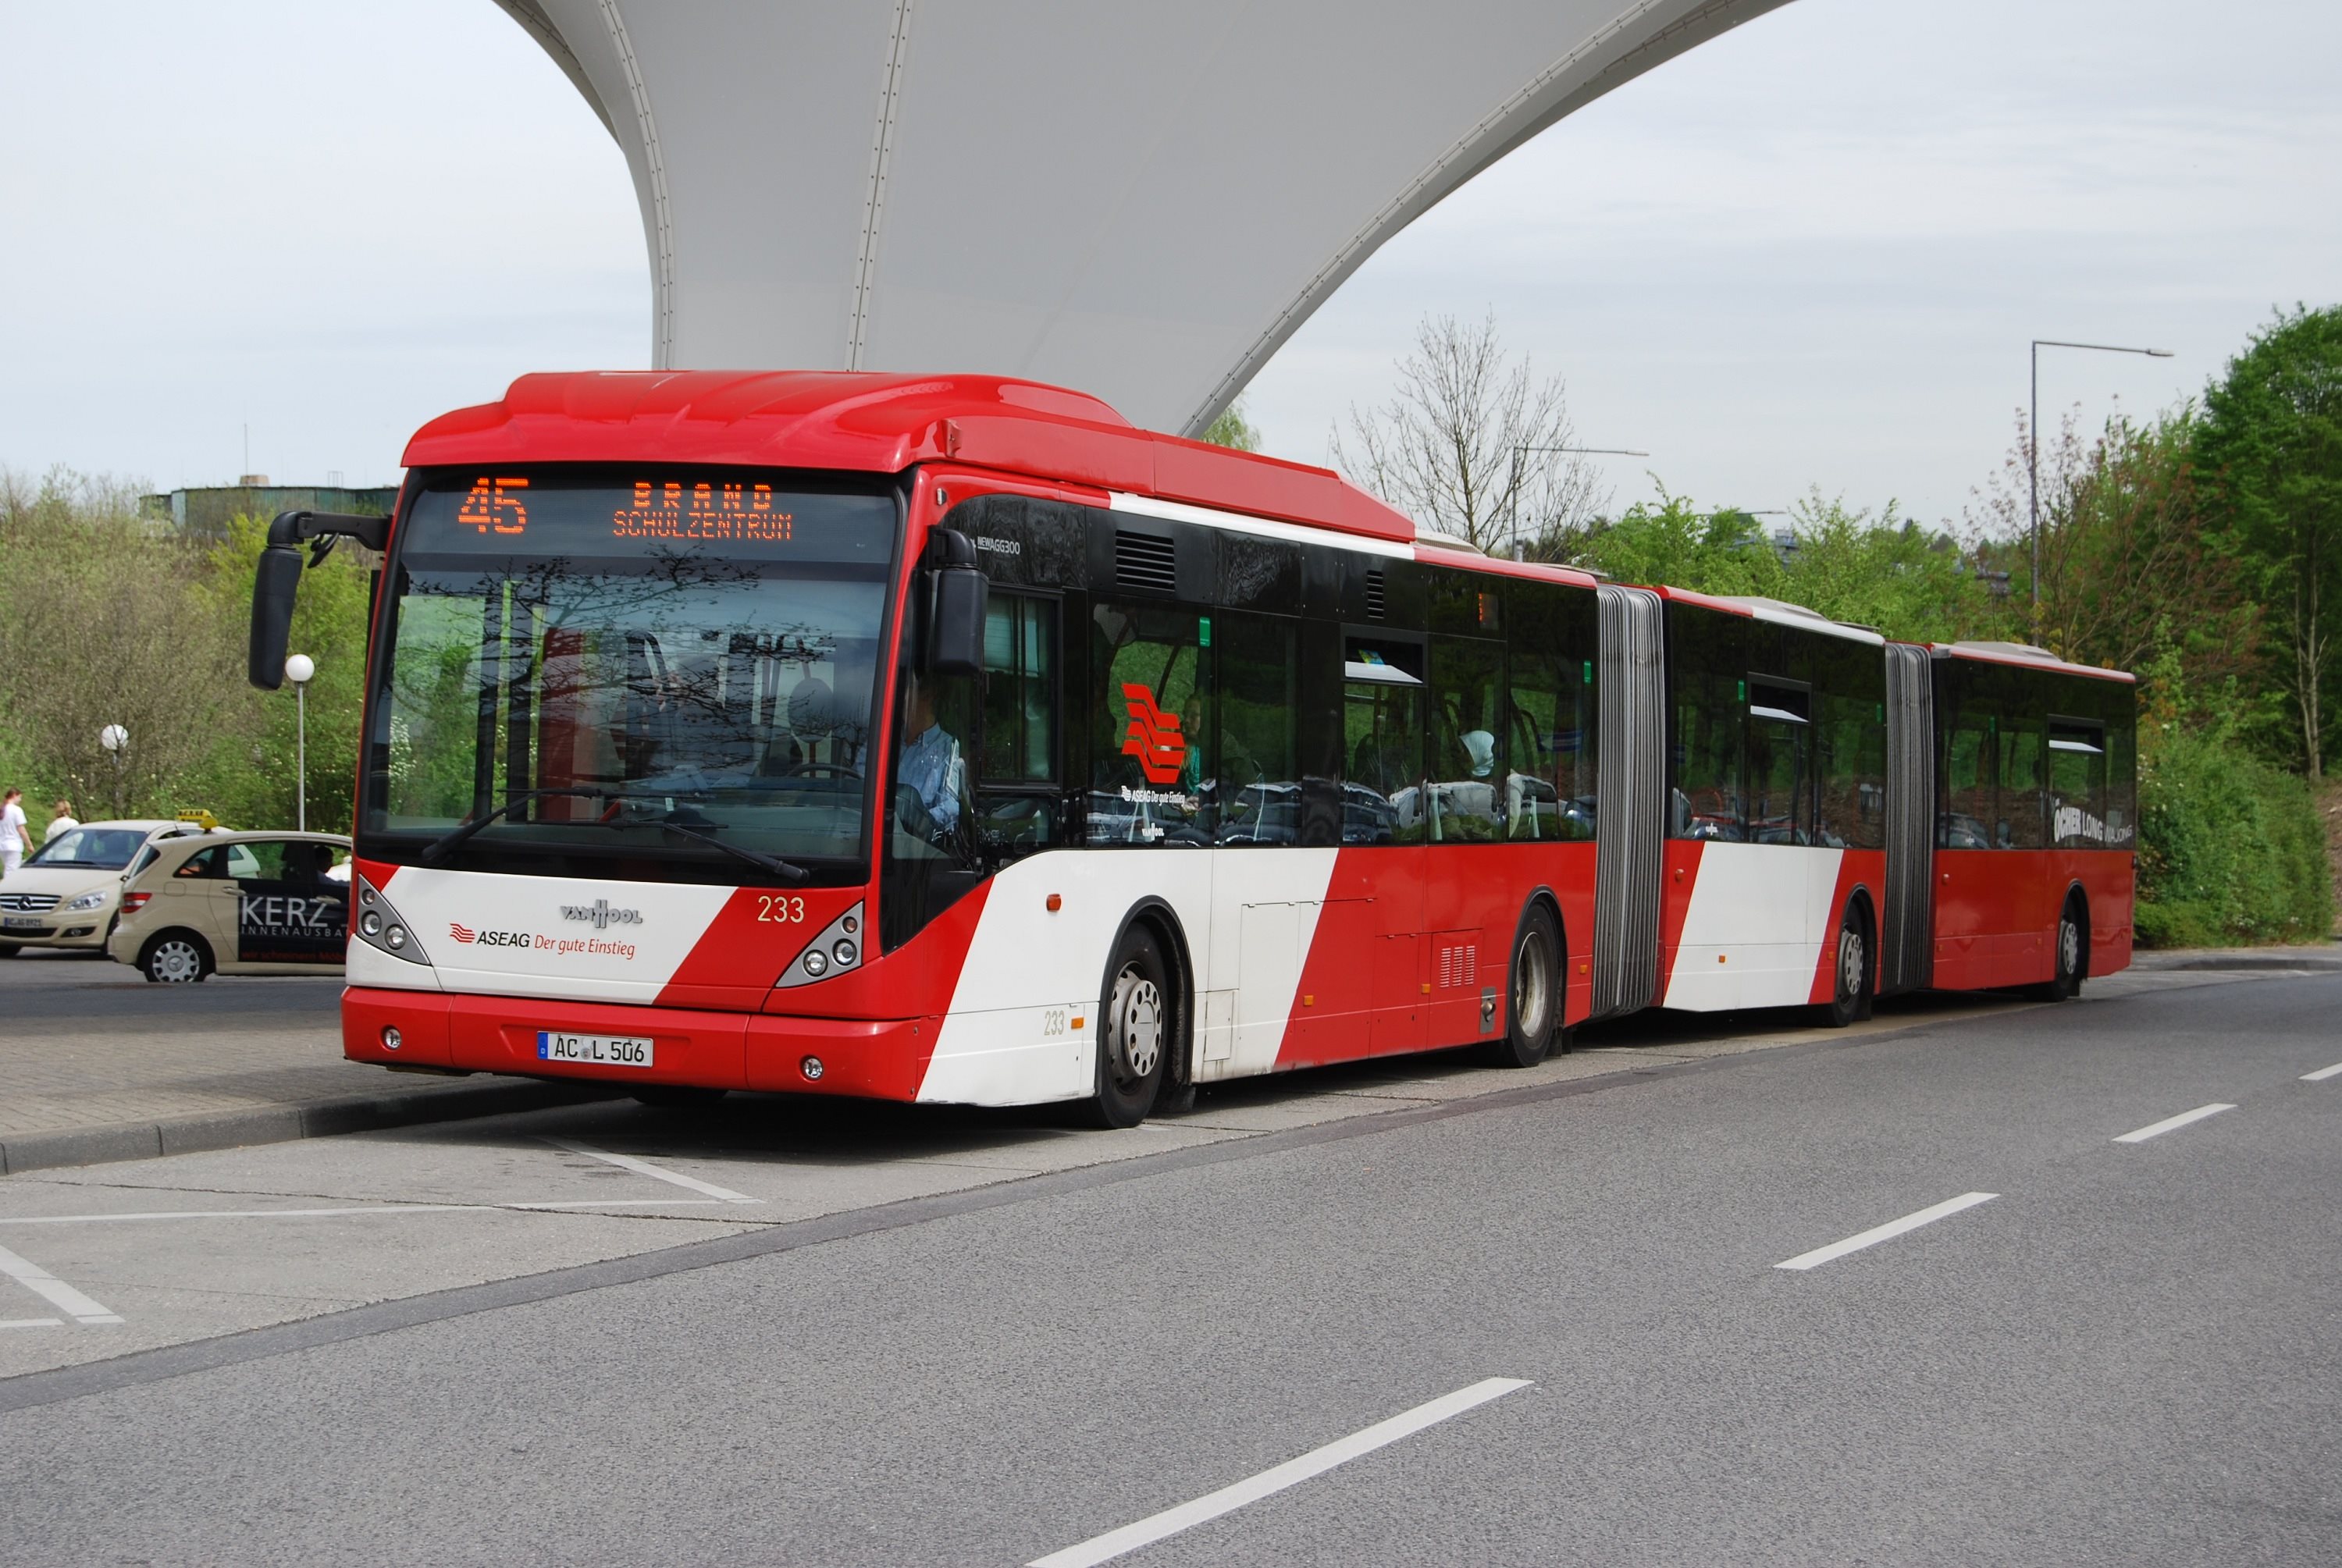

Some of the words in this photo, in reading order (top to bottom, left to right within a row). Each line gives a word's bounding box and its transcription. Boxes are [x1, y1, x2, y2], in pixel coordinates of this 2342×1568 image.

[458, 478, 529, 533] 45
[634, 482, 771, 510] BRAND
[614, 511, 792, 539] SCHULZENTRUM
[1131, 789, 1151, 802] ASEAG
[1151, 791, 1159, 802] Der
[1159, 792, 1169, 806] gute
[1169, 791, 1185, 807] Einstieg
[2082, 812, 2103, 841] LONG
[242, 896, 328, 927] KERZ
[757, 895, 805, 923] 233
[477, 930, 530, 948] ASEAG
[535, 934, 556, 950] Der
[557, 939, 586, 955] gute
[588, 938, 635, 960] Einstieg
[1044, 1010, 1064, 1036] 233
[554, 1037, 578, 1058] AC
[593, 1040, 604, 1059] L
[610, 1041, 645, 1062] 506
